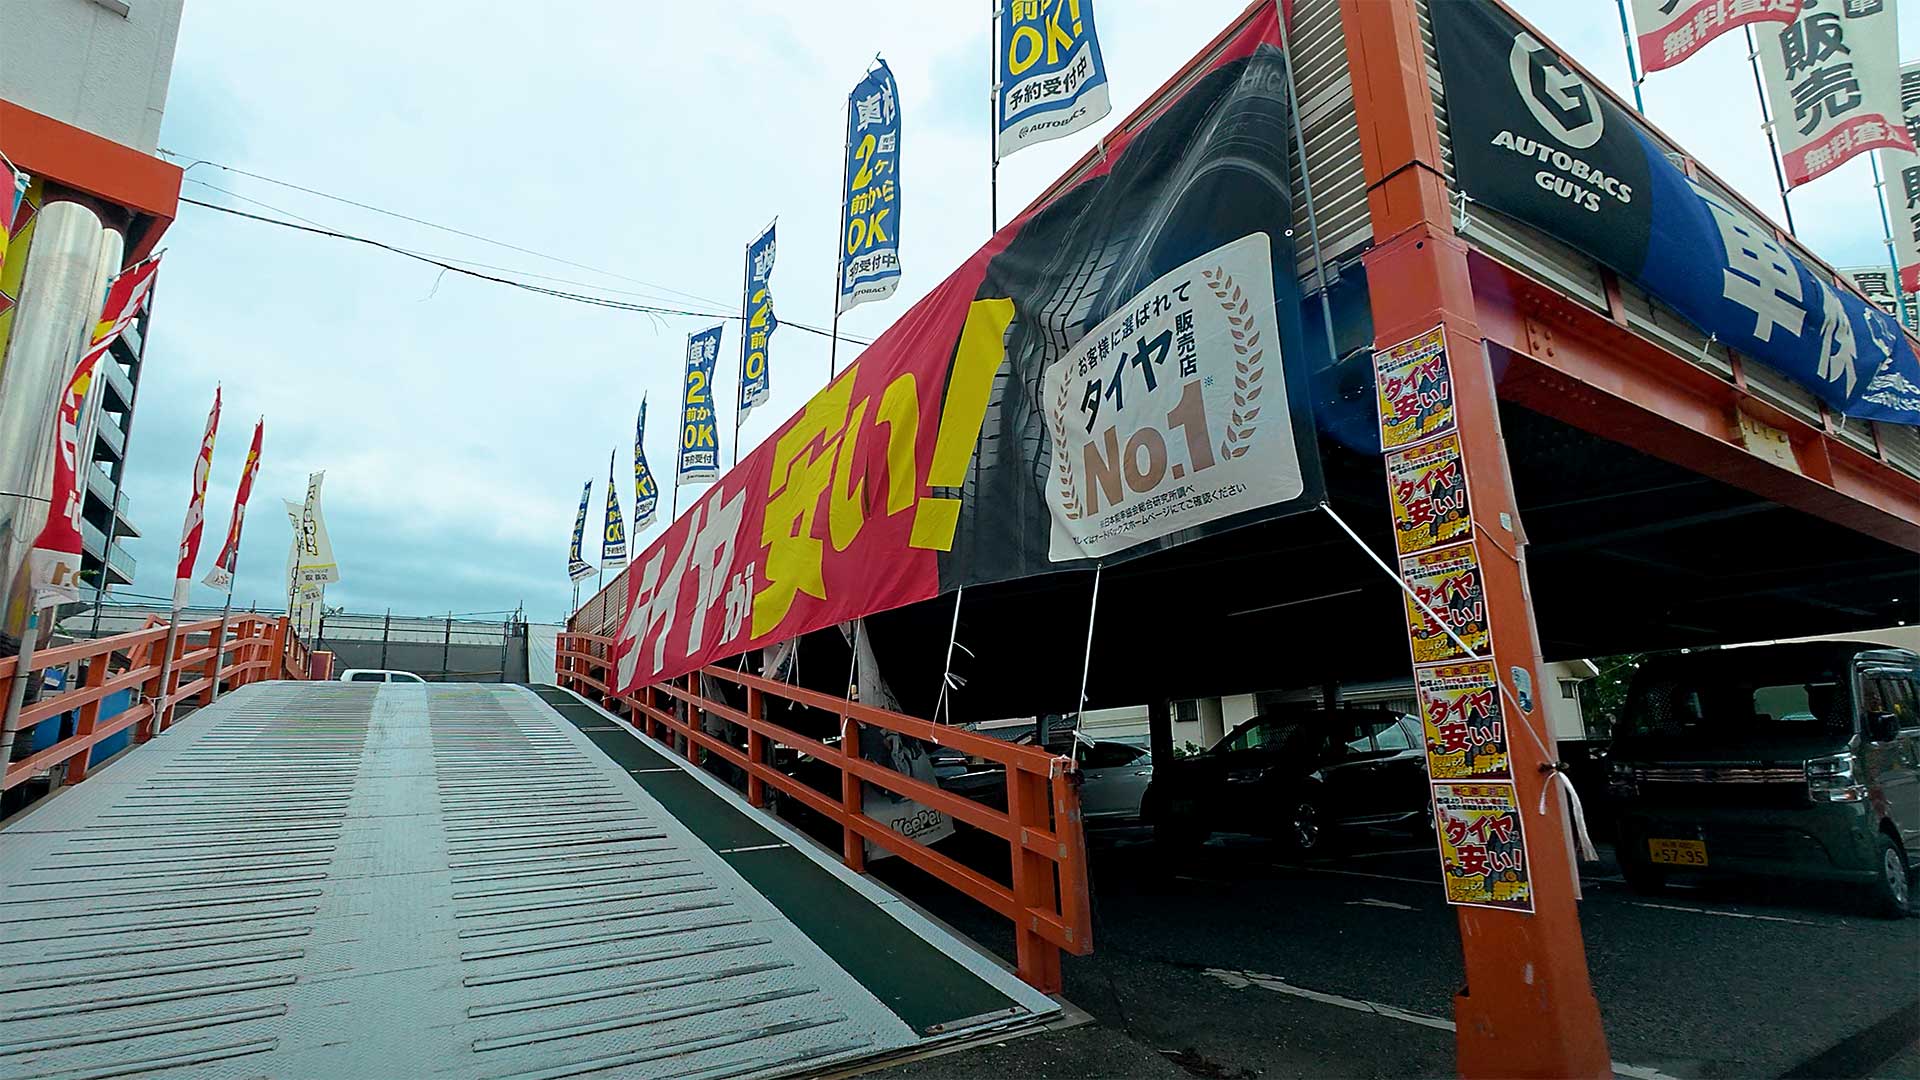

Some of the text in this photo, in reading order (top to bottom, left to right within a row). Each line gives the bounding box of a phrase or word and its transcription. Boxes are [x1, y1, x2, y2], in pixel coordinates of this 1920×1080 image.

[1008, 0, 1084, 76] OK!
[1009, 56, 1088, 111] 予約受付中
[1029, 106, 1087, 133] AUTOBACS
[1490, 130, 1633, 204] AUTOBACS
[1535, 170, 1601, 212] GUYS
[1077, 280, 1192, 378] お客様に選ばれて
[1174, 308, 1198, 378] 販売店
[1080, 327, 1174, 434] タイヤ
[1393, 381, 1449, 425] 安い!
[684, 423, 714, 449] OK
[1405, 489, 1464, 529] 安い!
[1438, 721, 1501, 754] 安い!
[1455, 844, 1522, 877] 安い!
